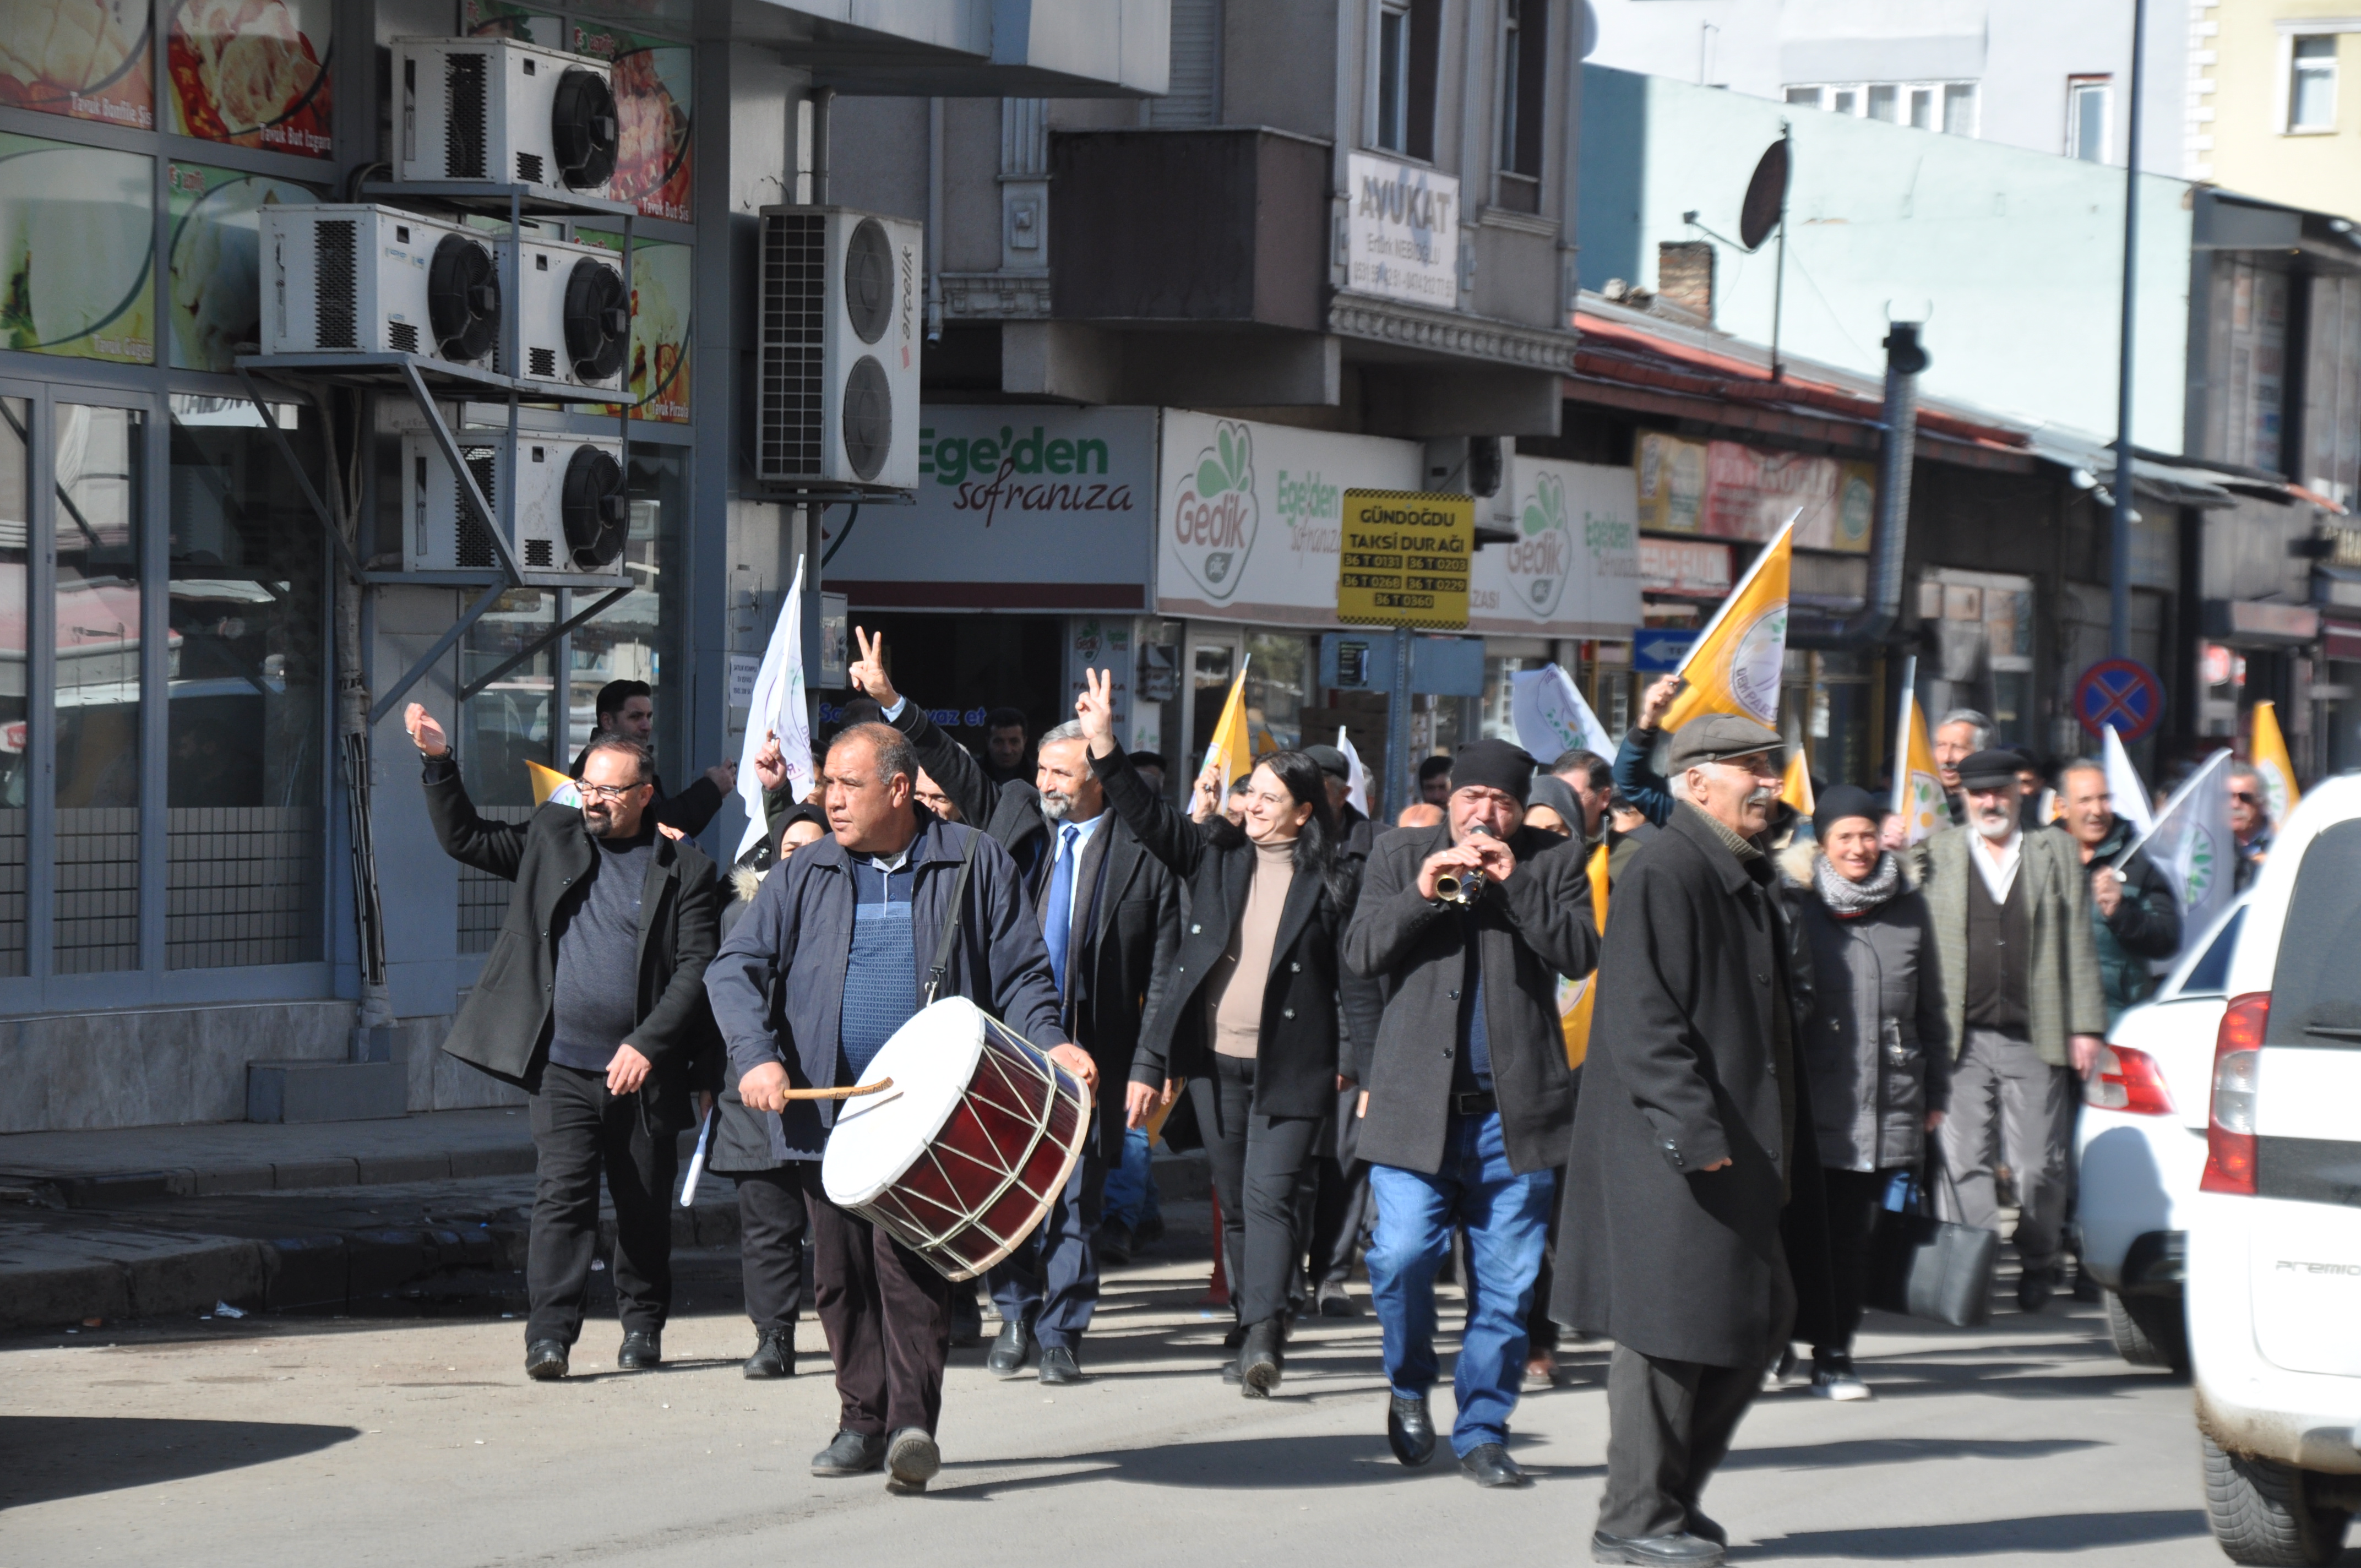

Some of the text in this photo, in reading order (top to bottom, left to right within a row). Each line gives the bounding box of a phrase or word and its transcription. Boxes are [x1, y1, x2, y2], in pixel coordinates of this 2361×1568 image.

[70, 91, 101, 115] Tavuk
[259, 122, 286, 143] Tavuk
[287, 126, 303, 146] But
[642, 197, 664, 216] Tavuk
[665, 201, 677, 219] But
[1359, 175, 1451, 235] AVUKAT
[93, 333, 121, 355] Tavuk
[651, 399, 669, 417] Tavuk
[919, 426, 1109, 486] Ege'den
[1277, 470, 1339, 527] Ege'den
[1176, 491, 1248, 549] Gedik
[1361, 505, 1455, 527] GÜNDOĞDU
[1350, 532, 1398, 550] TAKSİ
[1345, 555, 1401, 568] 36 T 0131
[1508, 530, 1563, 576] Gedik
[1408, 558, 1467, 571] 36 T 0203
[1343, 575, 1401, 588] 36 T 0268
[1408, 578, 1465, 591] 36 T 0229
[1376, 595, 1433, 607] 36 T 0360
[1471, 590, 1500, 609] ZASI
[1737, 667, 1778, 715] DEM PAR
[964, 700, 987, 727] et
